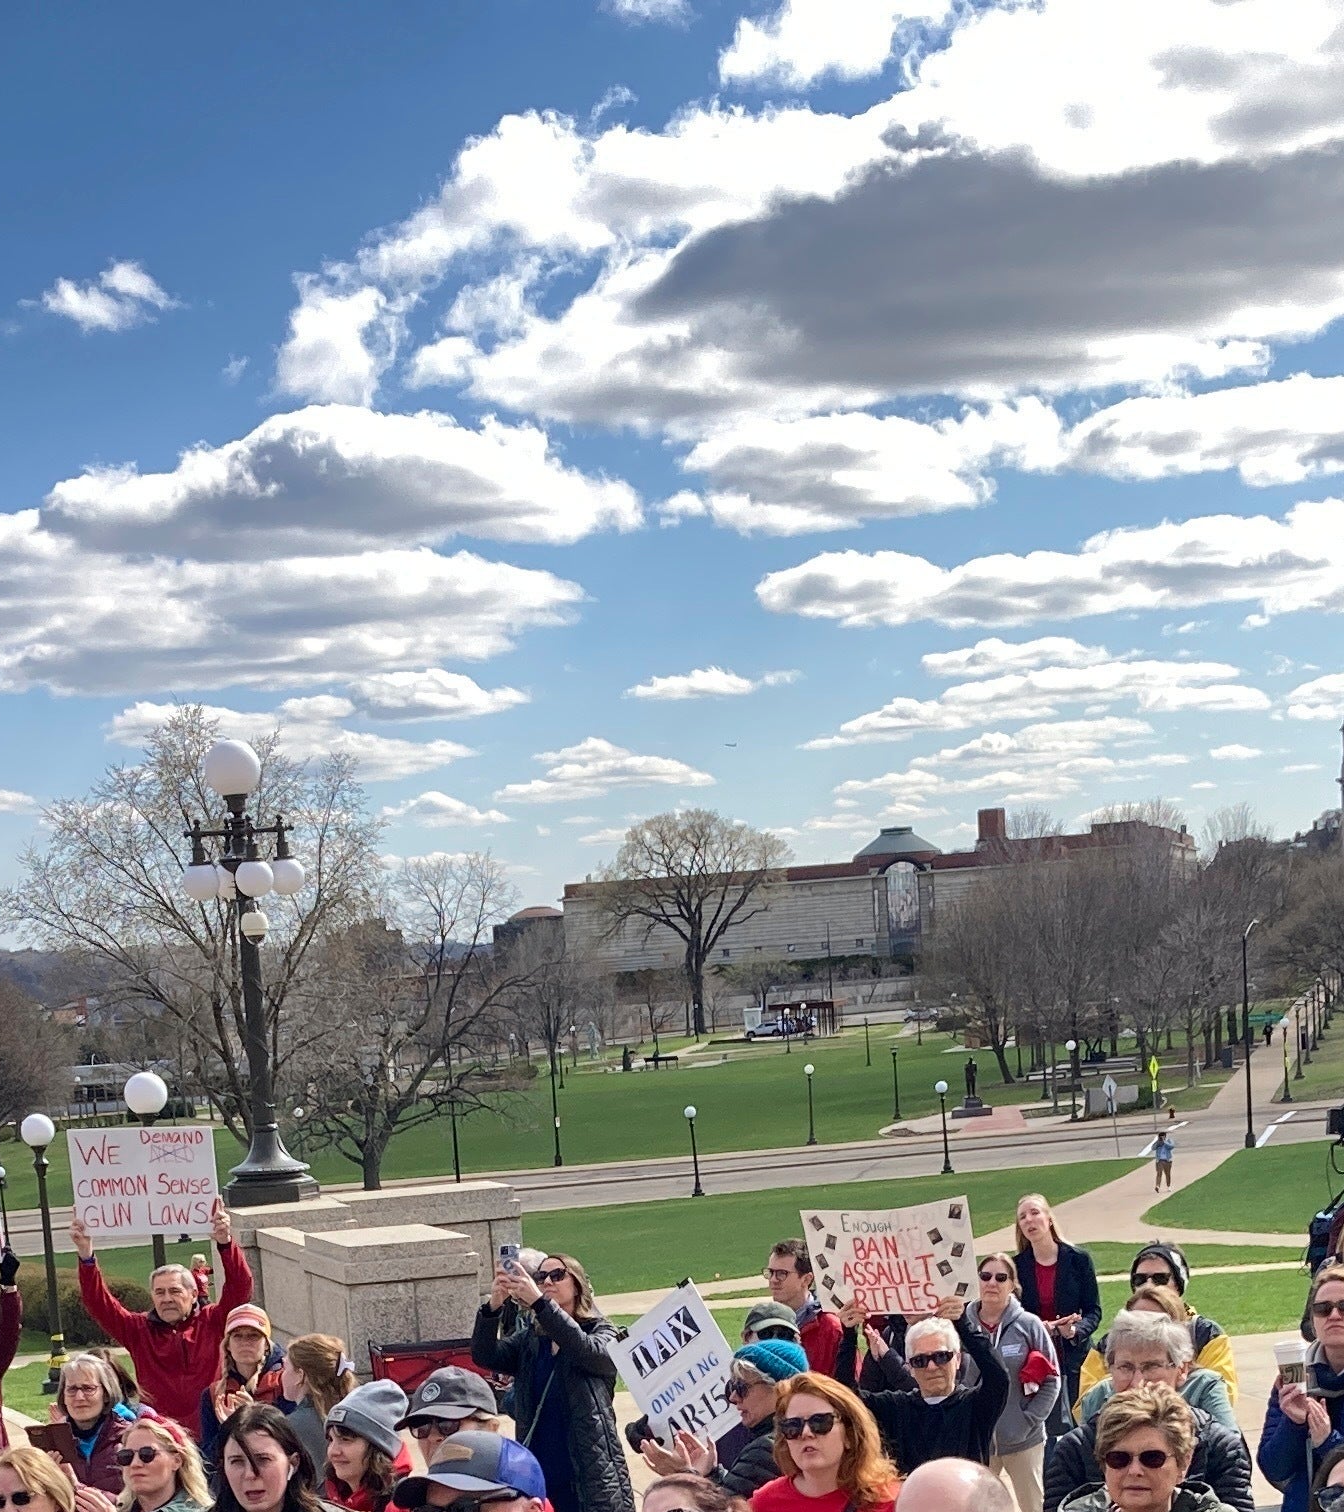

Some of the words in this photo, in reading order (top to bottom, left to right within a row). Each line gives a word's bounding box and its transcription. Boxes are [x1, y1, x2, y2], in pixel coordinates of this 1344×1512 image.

[75, 1135, 122, 1165] WE
[77, 1174, 148, 1198] COMMON
[83, 1201, 132, 1228] GUN
[852, 1235, 899, 1261] BAN
[843, 1253, 935, 1287] ASSAULT
[853, 1282, 941, 1313] RIFLES
[628, 1306, 701, 1379] TAX
